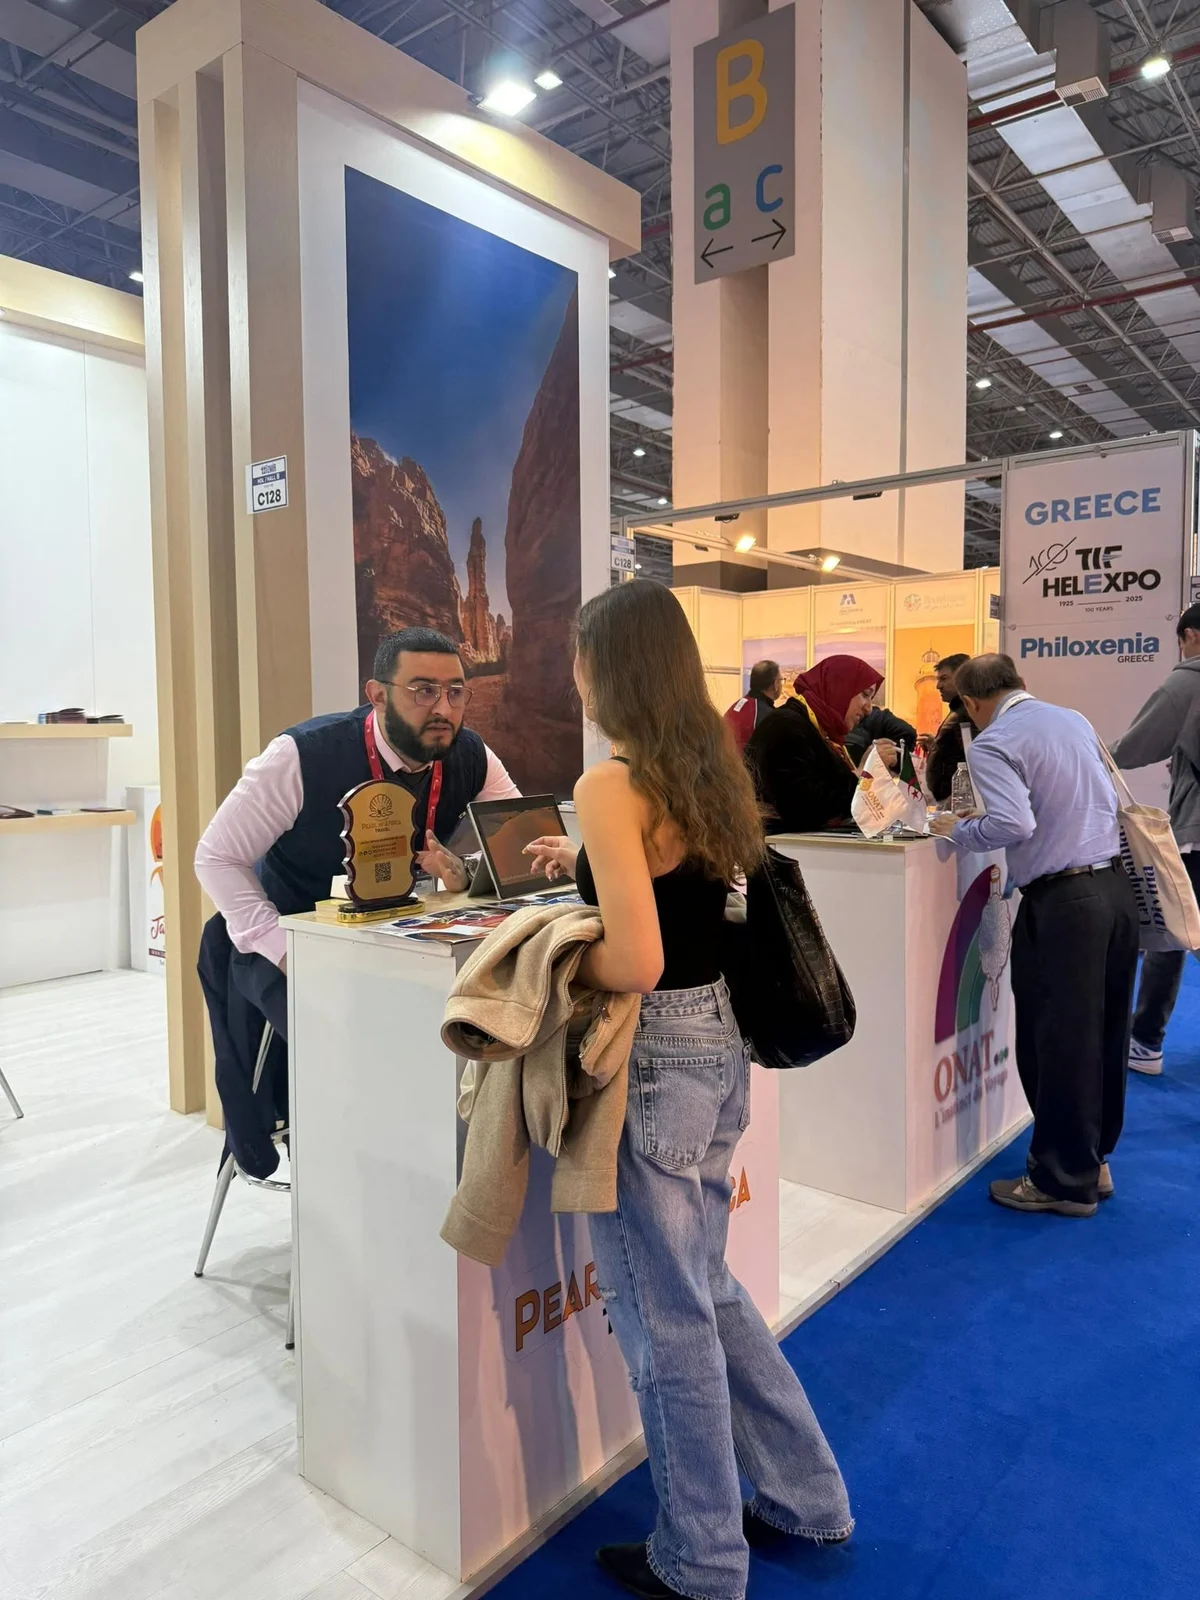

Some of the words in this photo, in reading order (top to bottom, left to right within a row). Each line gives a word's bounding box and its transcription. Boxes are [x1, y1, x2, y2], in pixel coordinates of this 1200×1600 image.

[716, 38, 768, 145] B
[703, 183, 731, 231] a
[257, 488, 282, 506] C128
[1024, 487, 1161, 526] GREECE
[614, 557, 631, 569] C128
[1075, 545, 1122, 571] TIF
[1042, 569, 1161, 598] HELEXPO
[1020, 632, 1160, 658] Philoxenia
[1117, 654, 1155, 664] GREECE
[515, 1261, 601, 1352] PEAR
